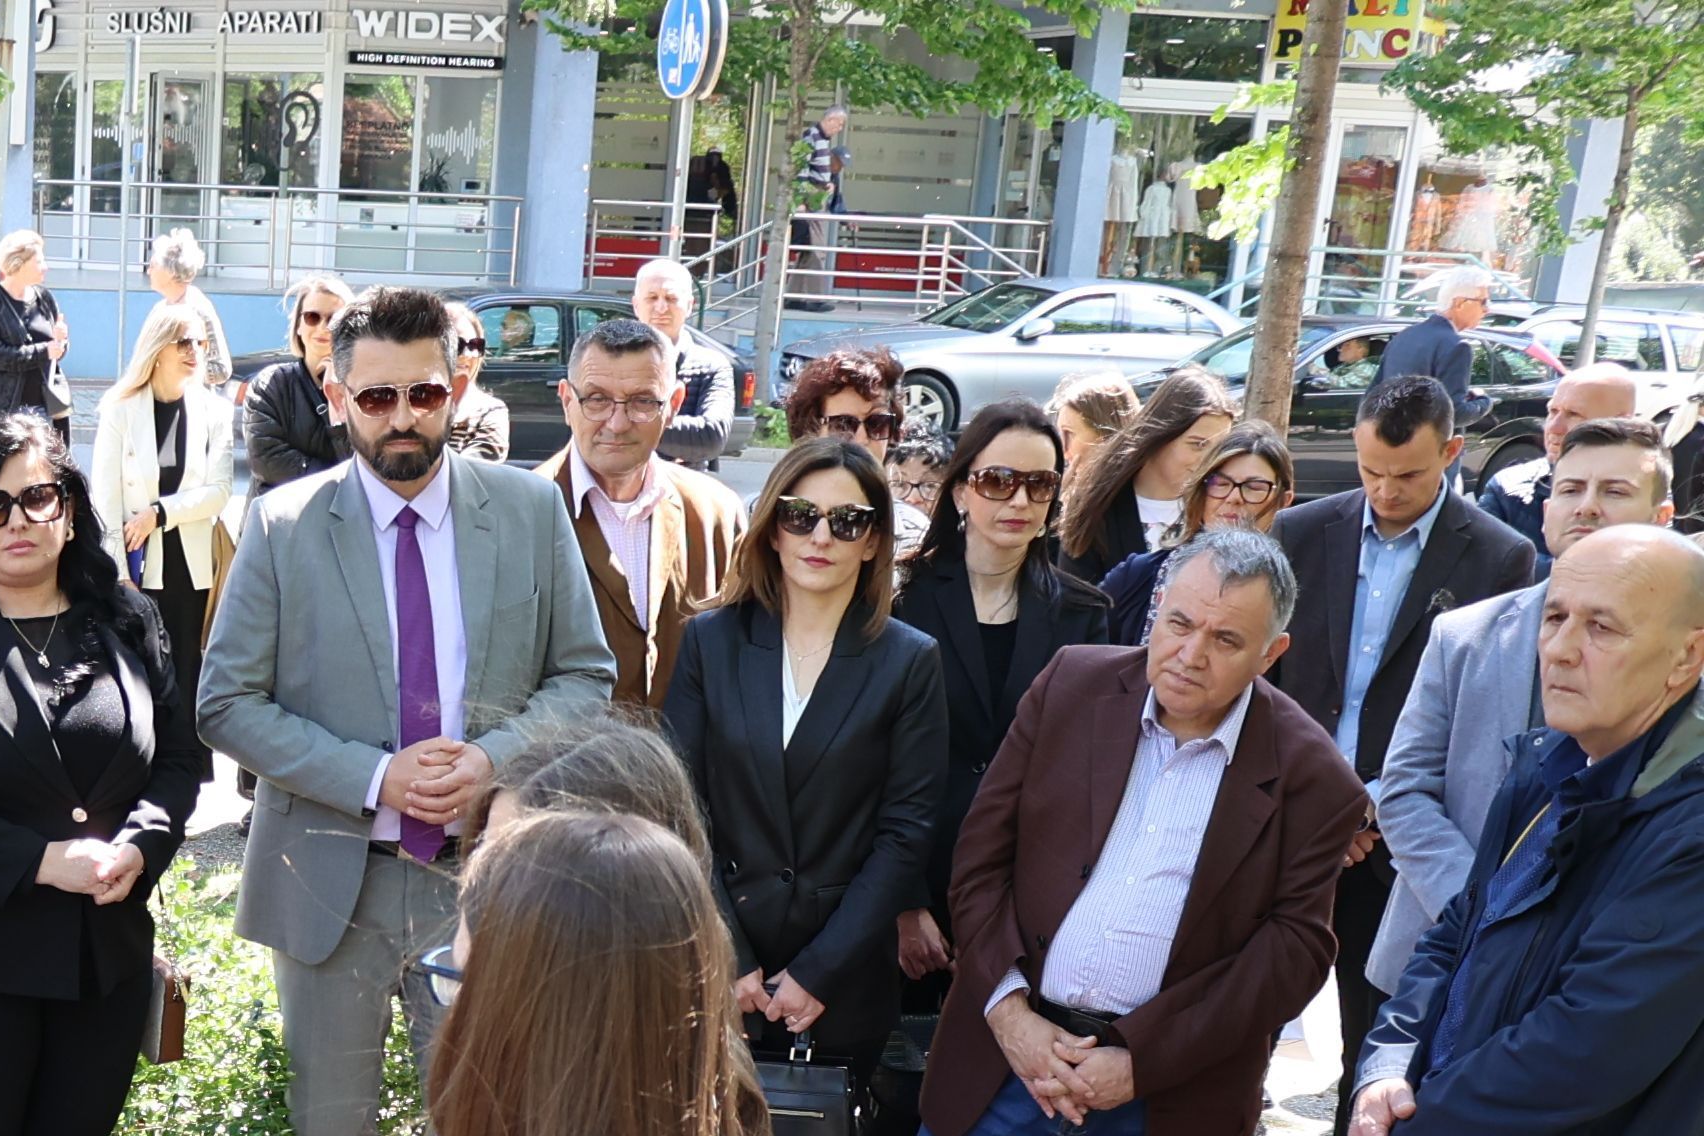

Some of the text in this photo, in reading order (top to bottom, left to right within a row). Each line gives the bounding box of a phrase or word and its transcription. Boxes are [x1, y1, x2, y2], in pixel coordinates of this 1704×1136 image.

[217, 10, 320, 33] APARATI
[353, 9, 506, 43] WIDEX
[1275, 28, 1411, 59] PNC
[357, 53, 495, 67] HIGH DEFINITION HEARING
